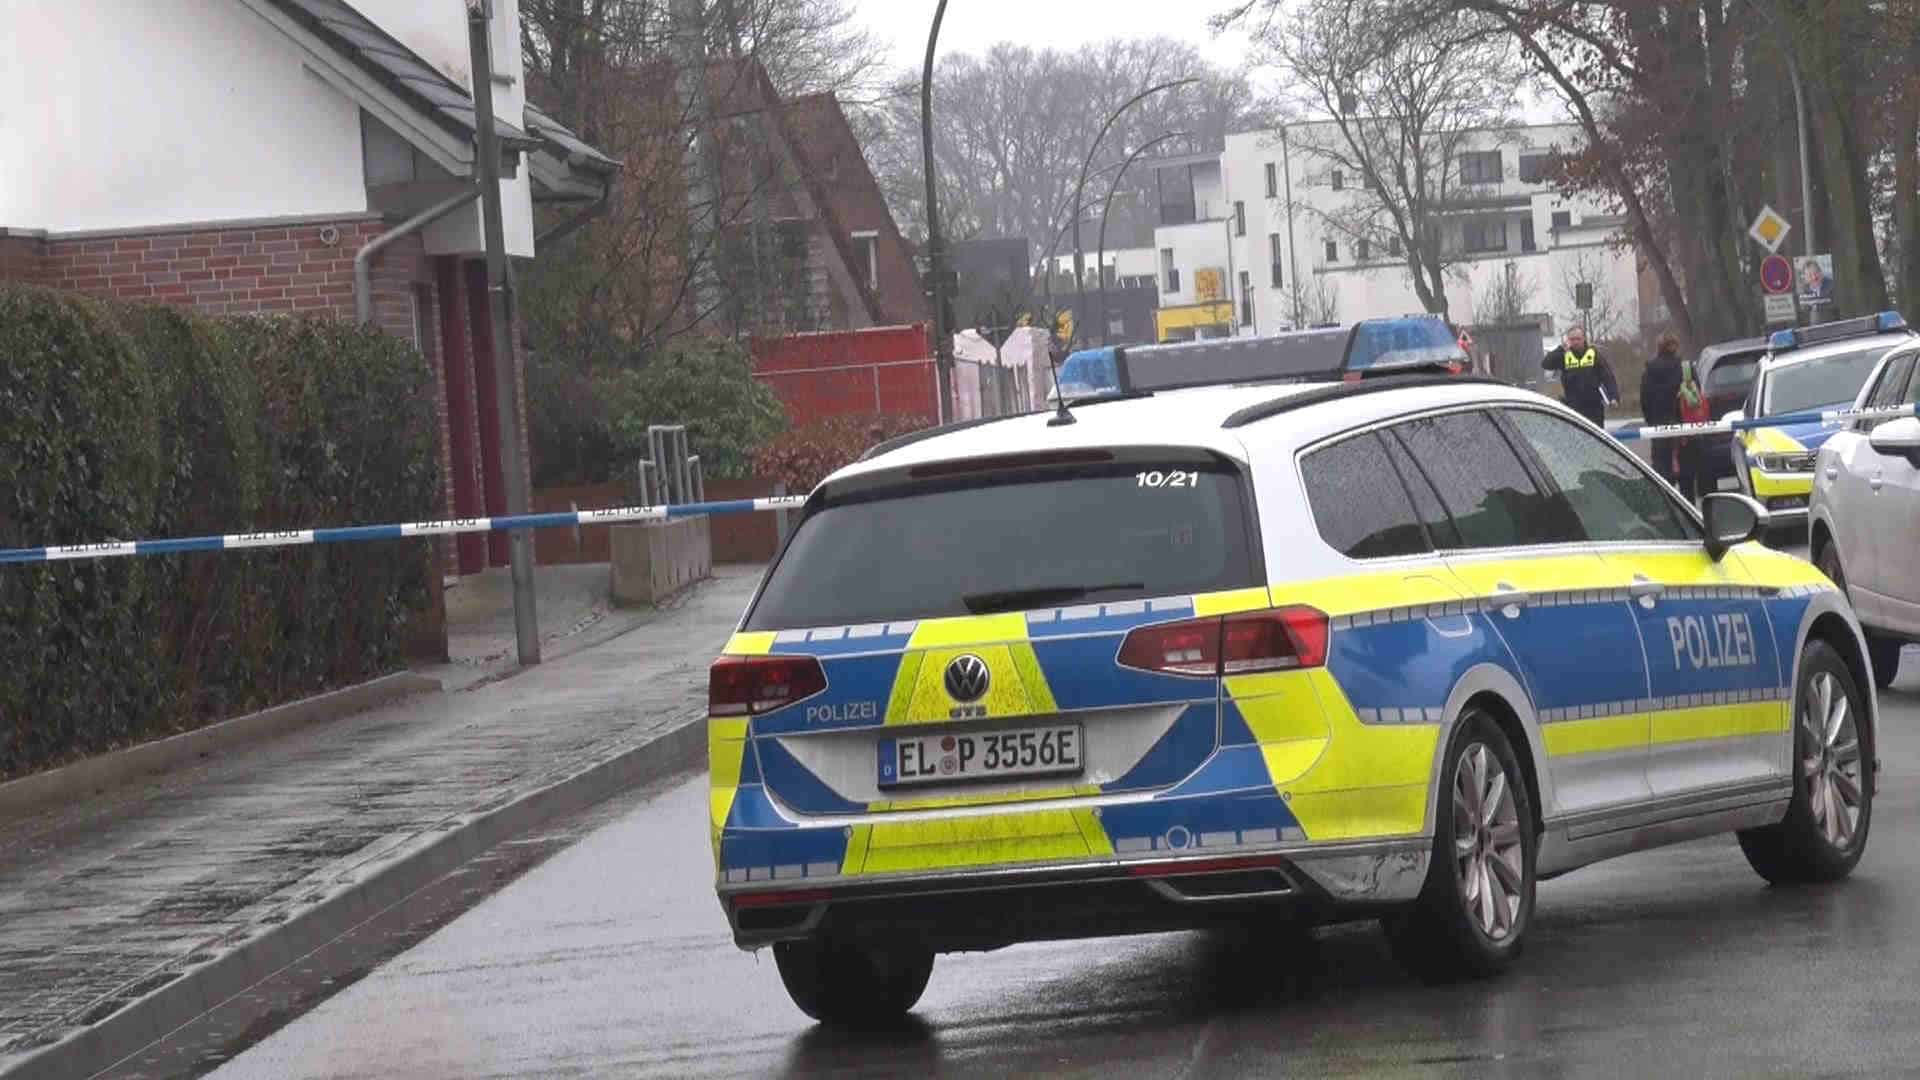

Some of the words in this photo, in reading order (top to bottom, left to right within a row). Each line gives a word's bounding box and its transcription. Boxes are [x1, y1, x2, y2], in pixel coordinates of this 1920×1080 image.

[1136, 470, 1198, 487] 10/21
[1667, 614, 1756, 670] POLIZEI
[806, 701, 876, 722] POLIZEI
[899, 742, 936, 777] EL
[958, 738, 975, 772] P
[984, 731, 1076, 771] 3556E
